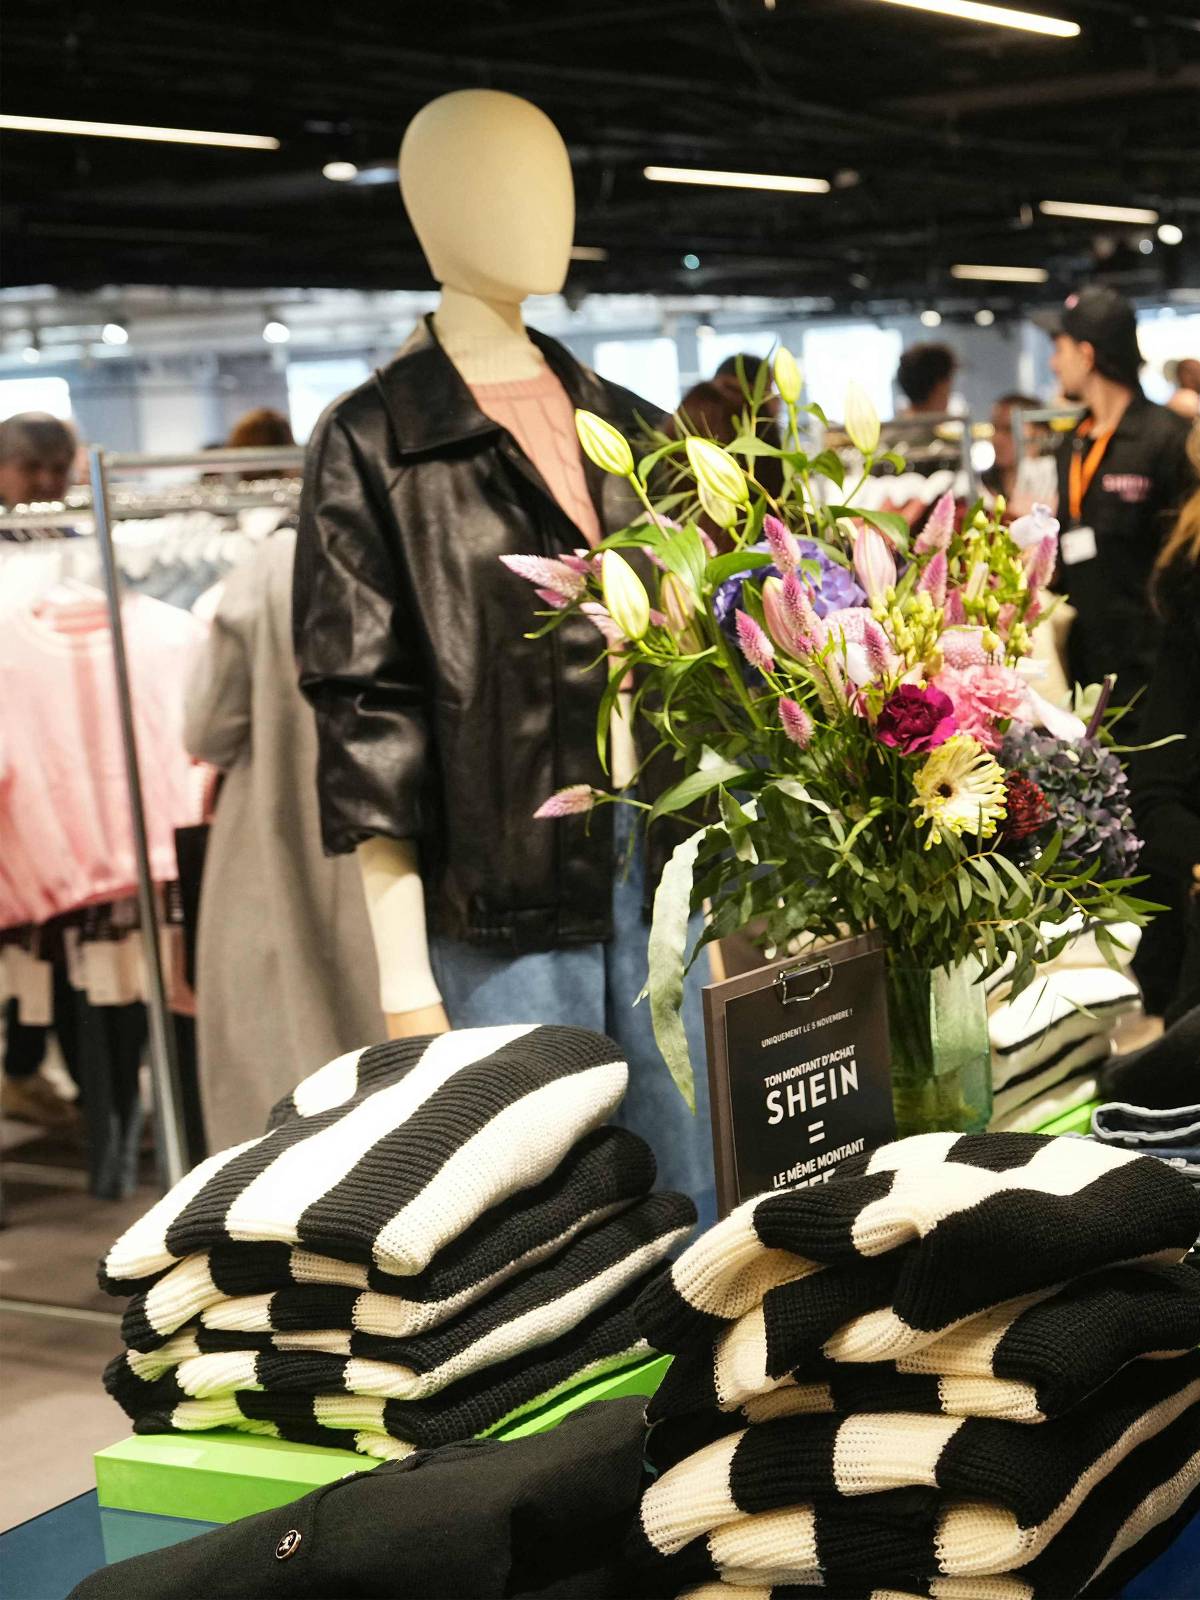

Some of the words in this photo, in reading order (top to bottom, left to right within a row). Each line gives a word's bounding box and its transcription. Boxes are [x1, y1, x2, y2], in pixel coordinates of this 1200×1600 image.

[761, 1026, 802, 1048] UNIQUEMENT
[803, 1023, 811, 1033] LE
[811, 1021, 816, 1030] 5
[816, 1009, 849, 1028] NOVEMBRE
[764, 1072, 782, 1089] TON
[782, 1057, 821, 1082] MONTANT
[821, 1044, 855, 1067] D'ACHAT
[766, 1059, 859, 1125] SHEIN
[808, 1120, 826, 1144] =
[773, 1172, 786, 1189] LE
[786, 1159, 817, 1183] MÊME
[816, 1137, 865, 1170] MONTANT
